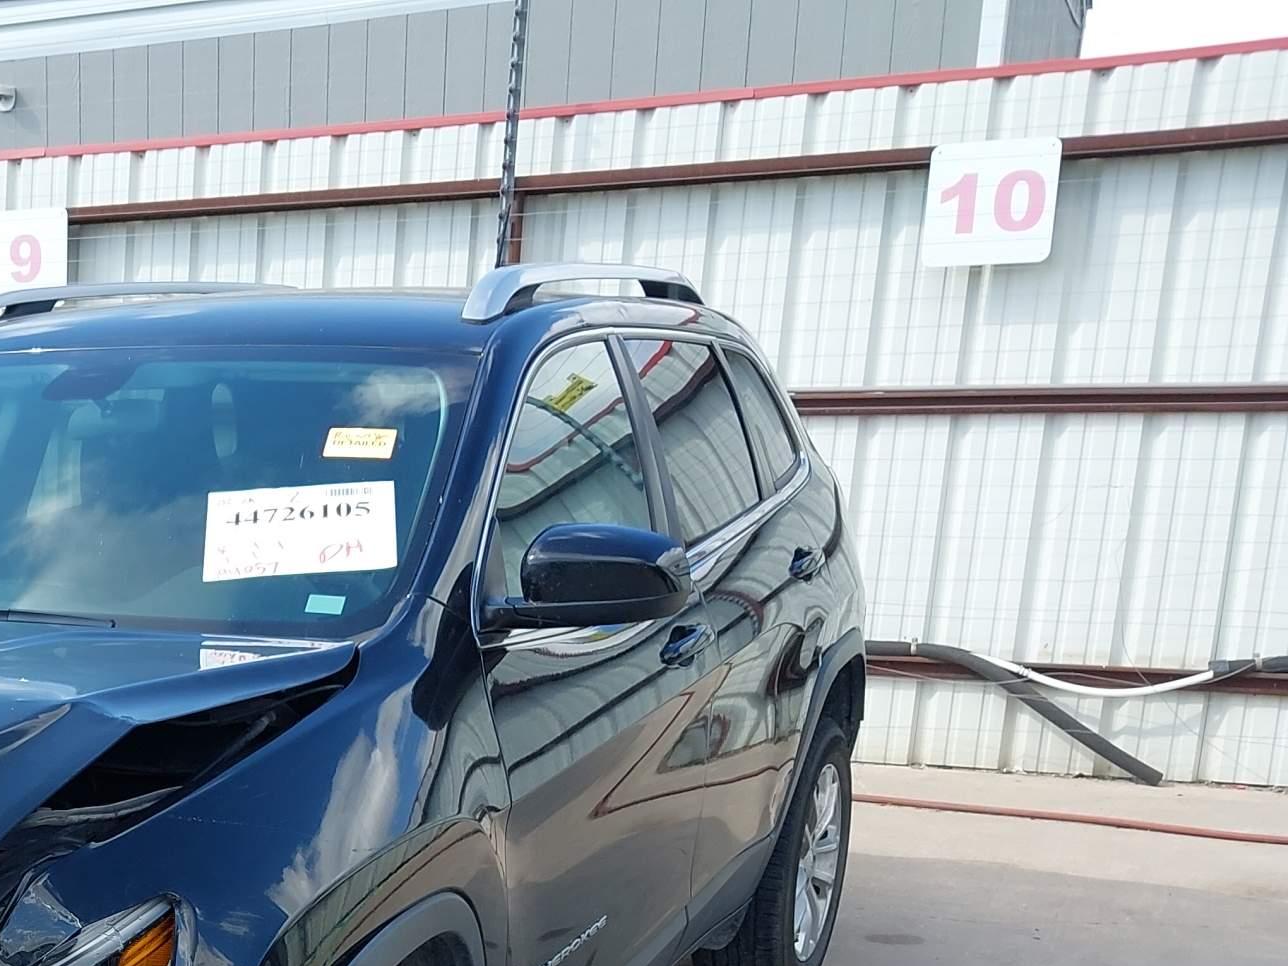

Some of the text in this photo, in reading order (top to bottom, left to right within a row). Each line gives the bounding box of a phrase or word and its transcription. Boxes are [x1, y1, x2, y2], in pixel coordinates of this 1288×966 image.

[940, 169, 1046, 234] 10
[10, 234, 42, 283] 9
[226, 501, 371, 526] 44726105
